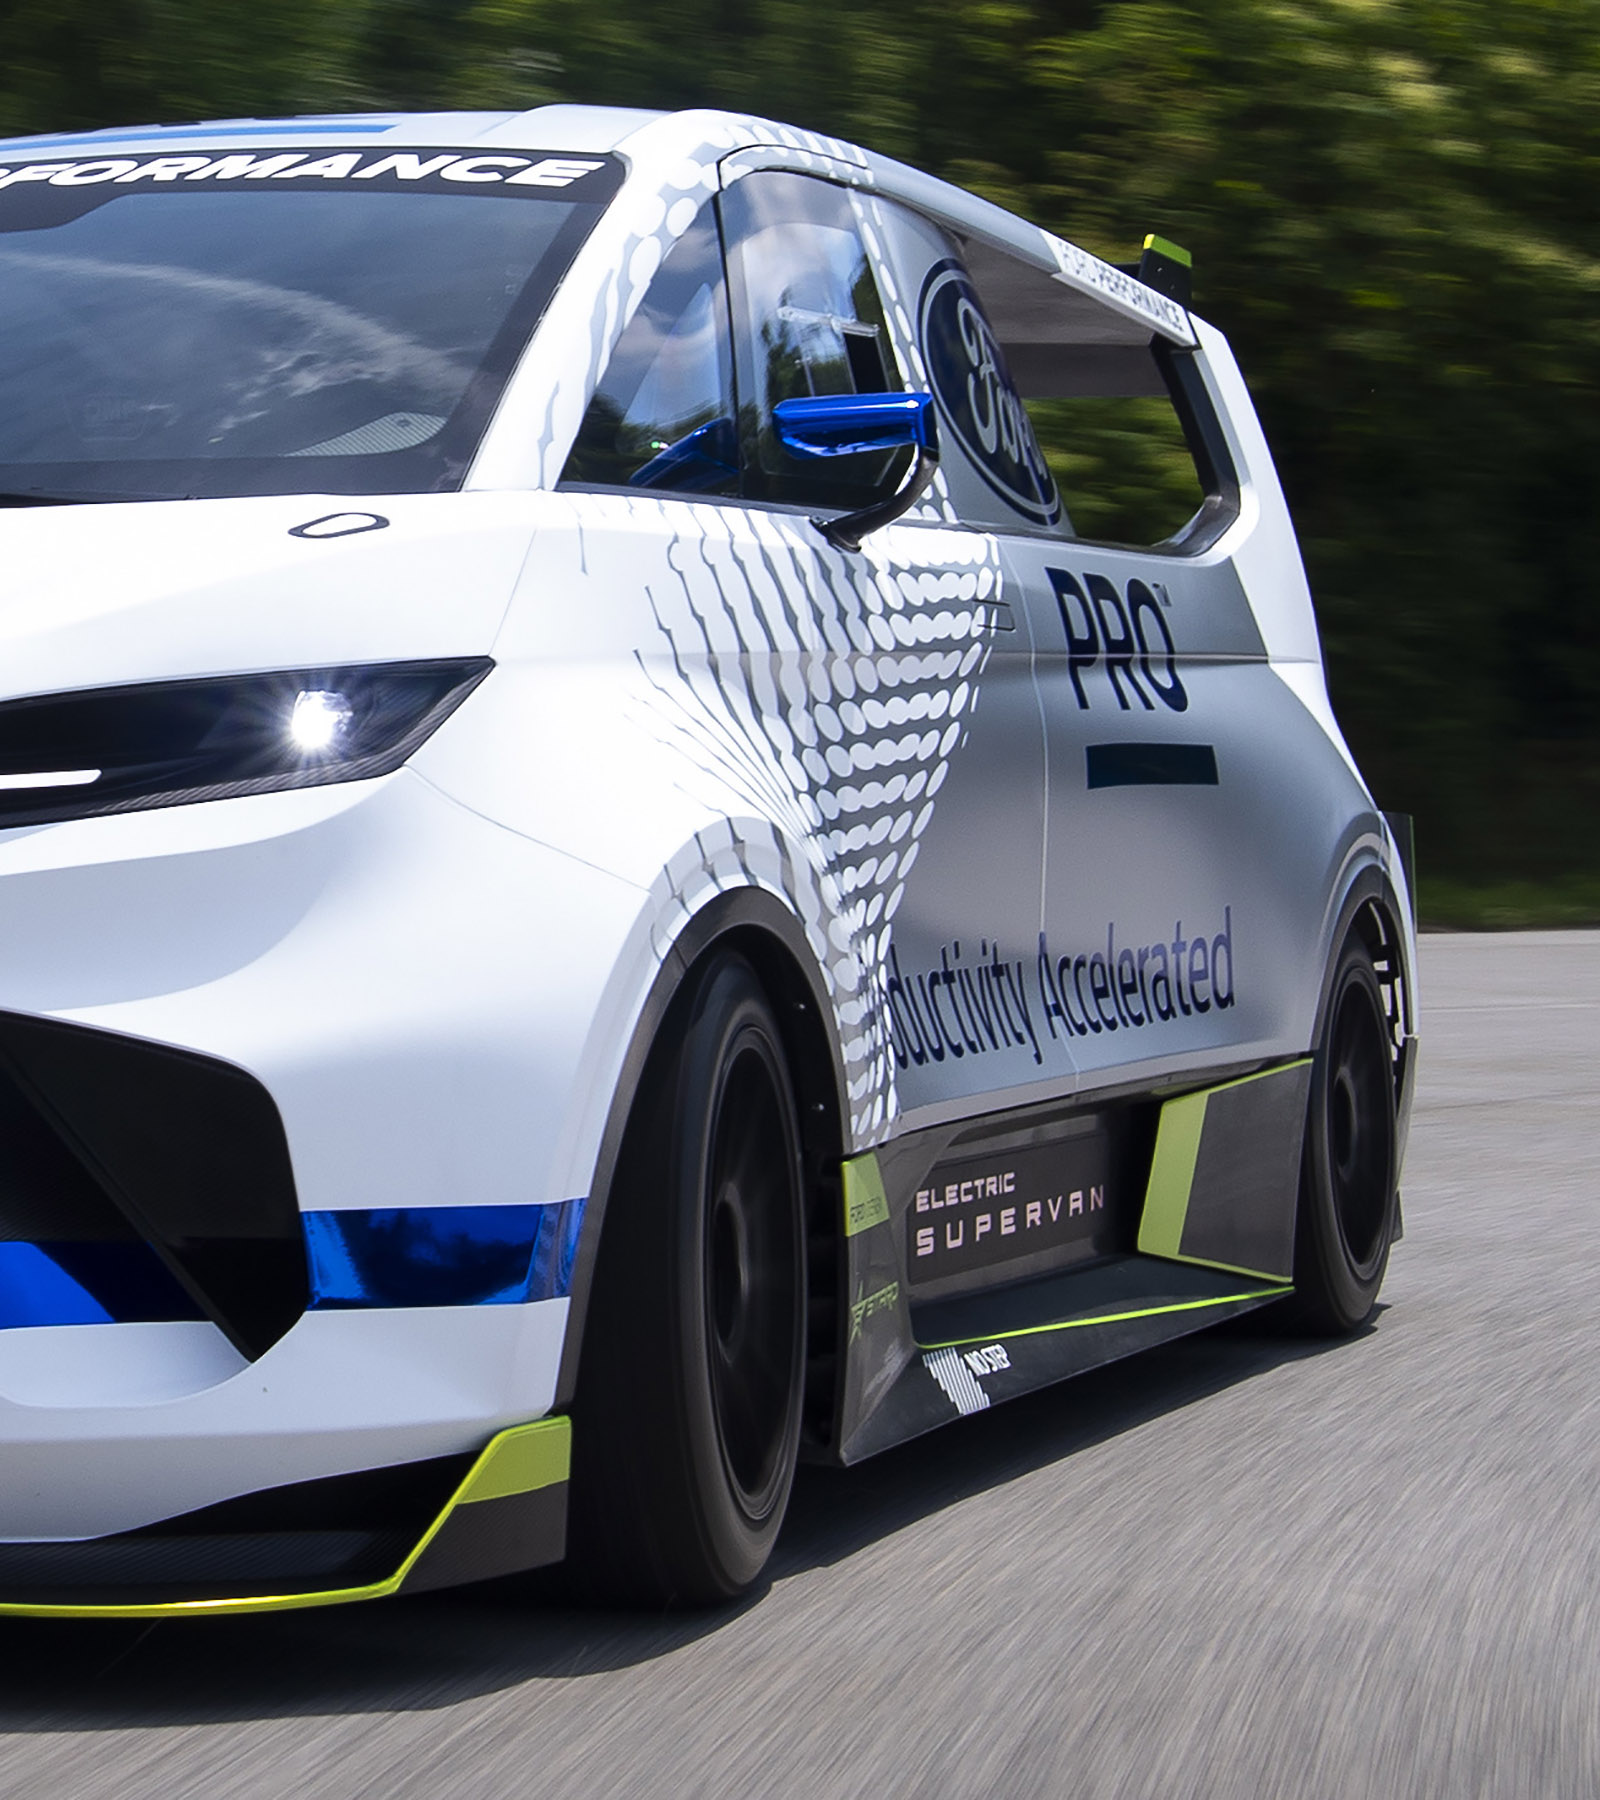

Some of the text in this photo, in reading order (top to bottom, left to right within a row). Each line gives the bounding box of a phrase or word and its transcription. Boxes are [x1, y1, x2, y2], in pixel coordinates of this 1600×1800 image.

[1044, 566, 1188, 712] PRO
[1037, 904, 1235, 1041] Accelerated
[916, 1172, 1016, 1213] ELECTRIC
[916, 1184, 1105, 1257] SUPERVAN
